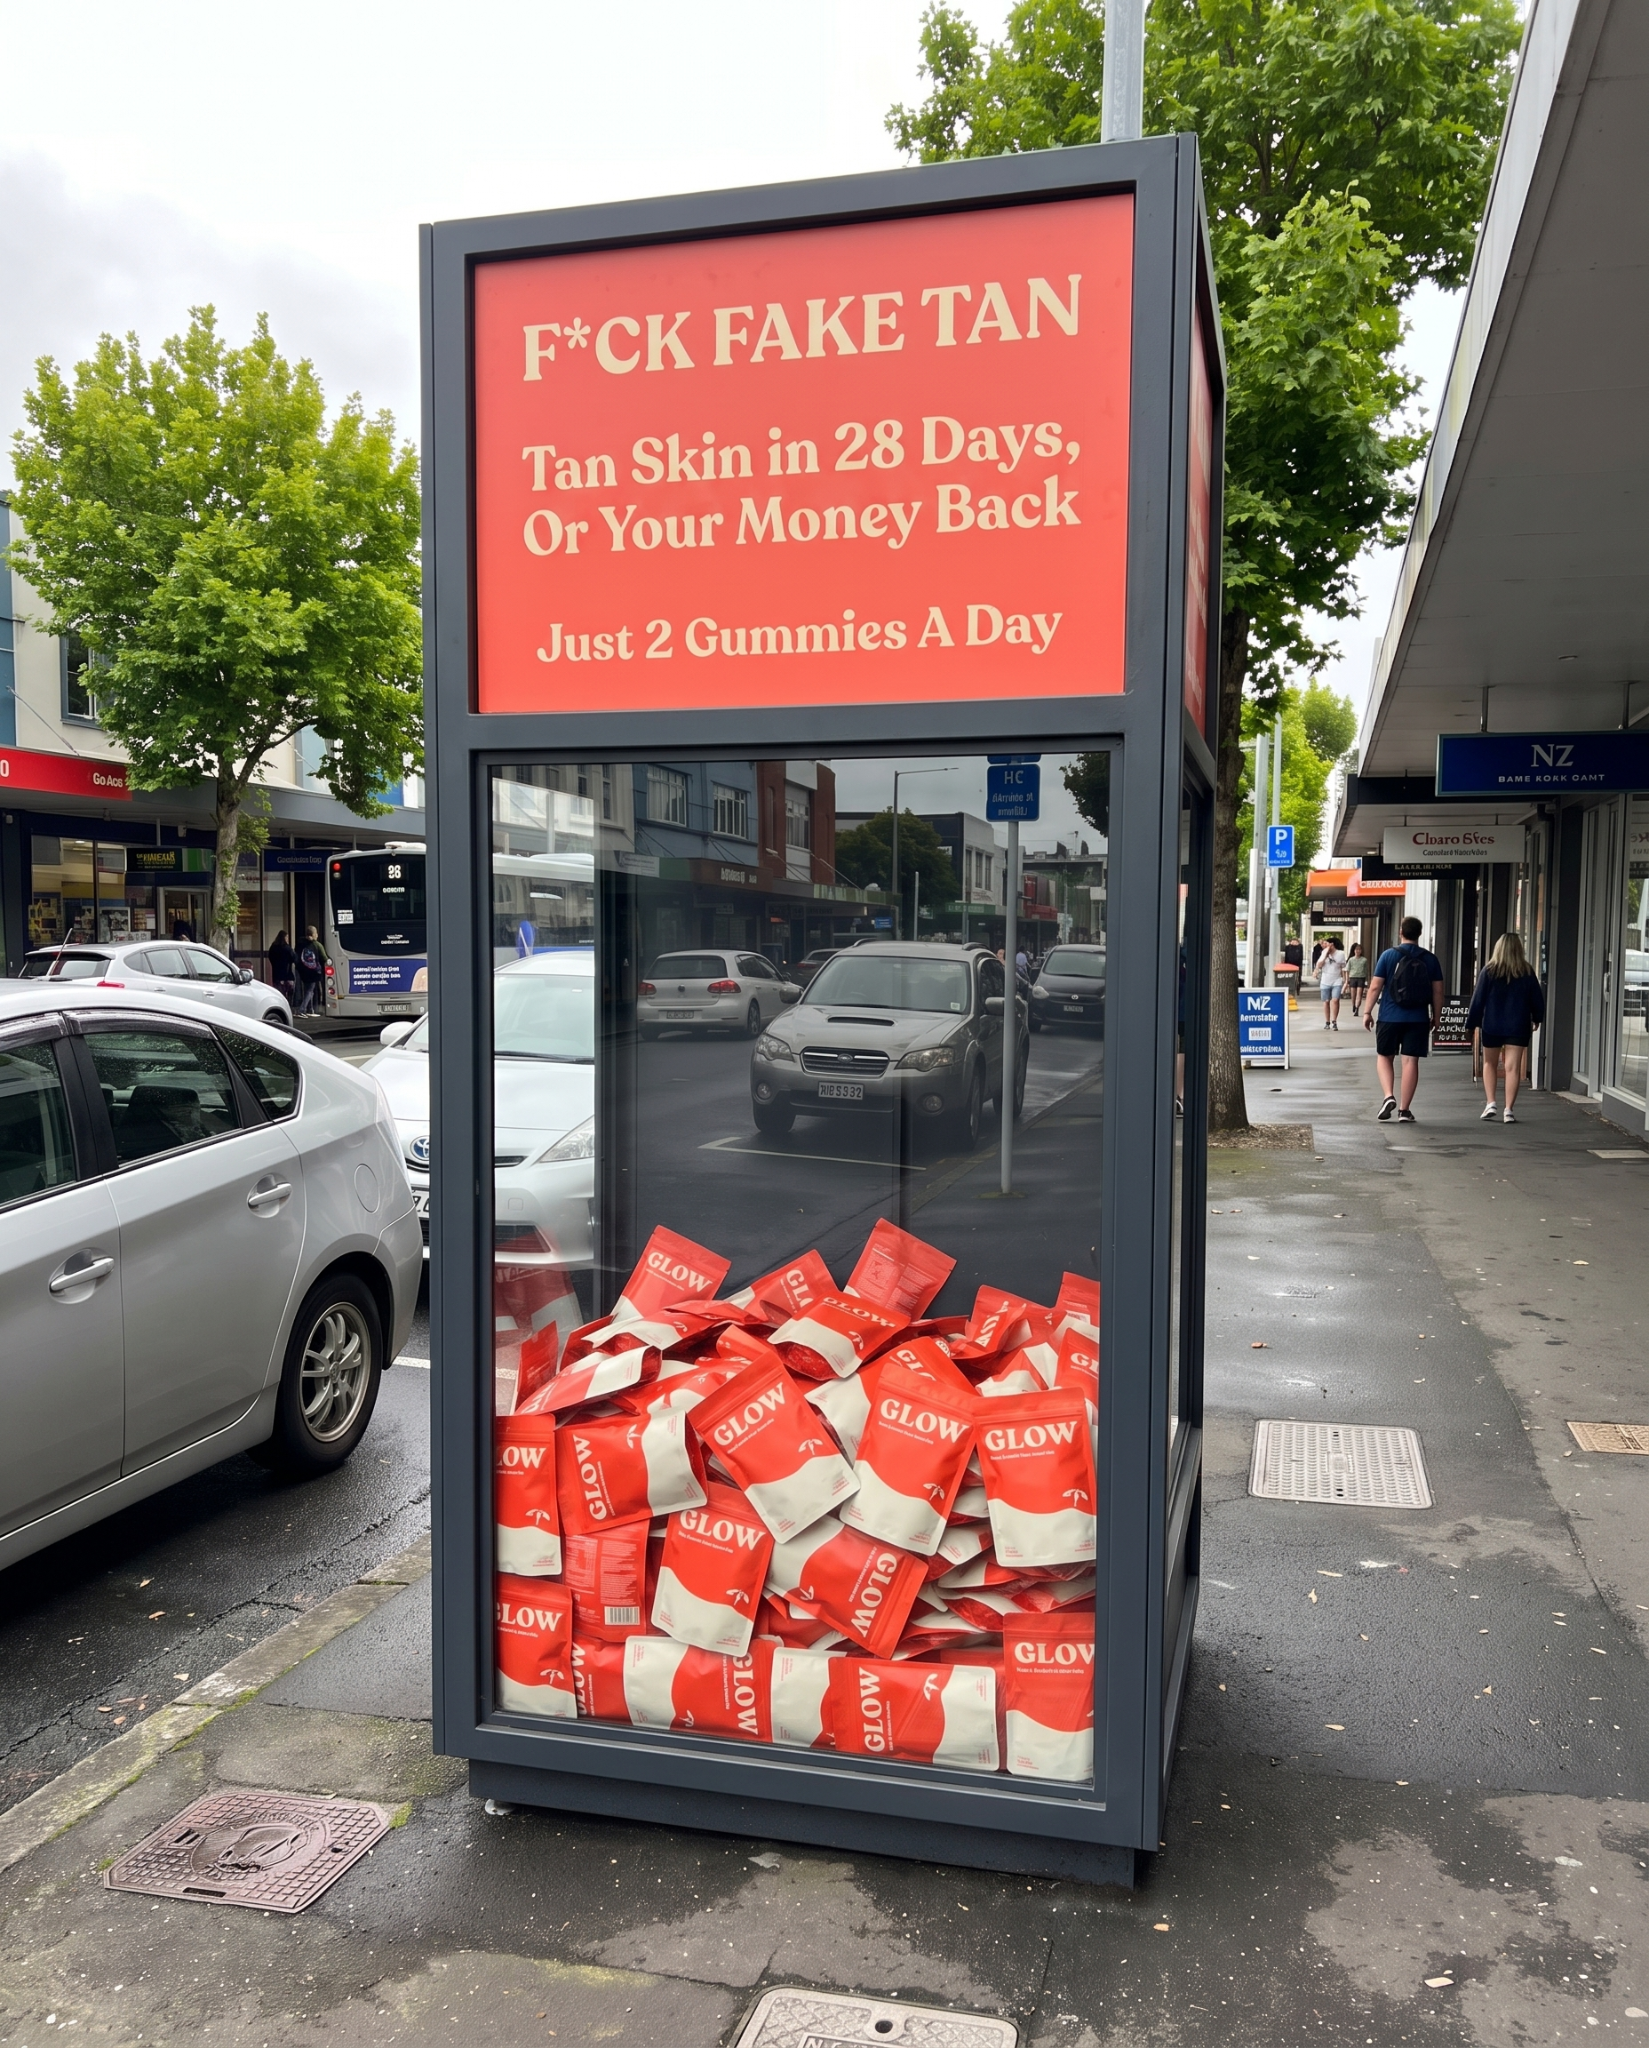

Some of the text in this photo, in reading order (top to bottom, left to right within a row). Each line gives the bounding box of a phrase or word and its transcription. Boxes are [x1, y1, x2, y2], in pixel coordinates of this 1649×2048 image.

[713, 291, 905, 366] FAKE
[920, 273, 1082, 347] TAN
[521, 416, 1081, 491] Tan Skin in 28 Days,
[523, 474, 1082, 556] Or Your Money Back
[536, 604, 1063, 663] Just 2 Gummies A Day
[1530, 743, 1575, 768] NZ
[1275, 829, 1288, 846] P
[647, 1251, 714, 1293] GLOW
[713, 1382, 786, 1447] GLOW
[879, 1398, 971, 1444] GLOW
[984, 1421, 1078, 1452] GLOW
[572, 1434, 608, 1521] GLOW
[679, 1508, 767, 1552] GLOW
[496, 1601, 564, 1633] LOW
[850, 1552, 898, 1639] GLOW
[732, 1651, 759, 1736] GLOW
[858, 1665, 886, 1753] GLOW
